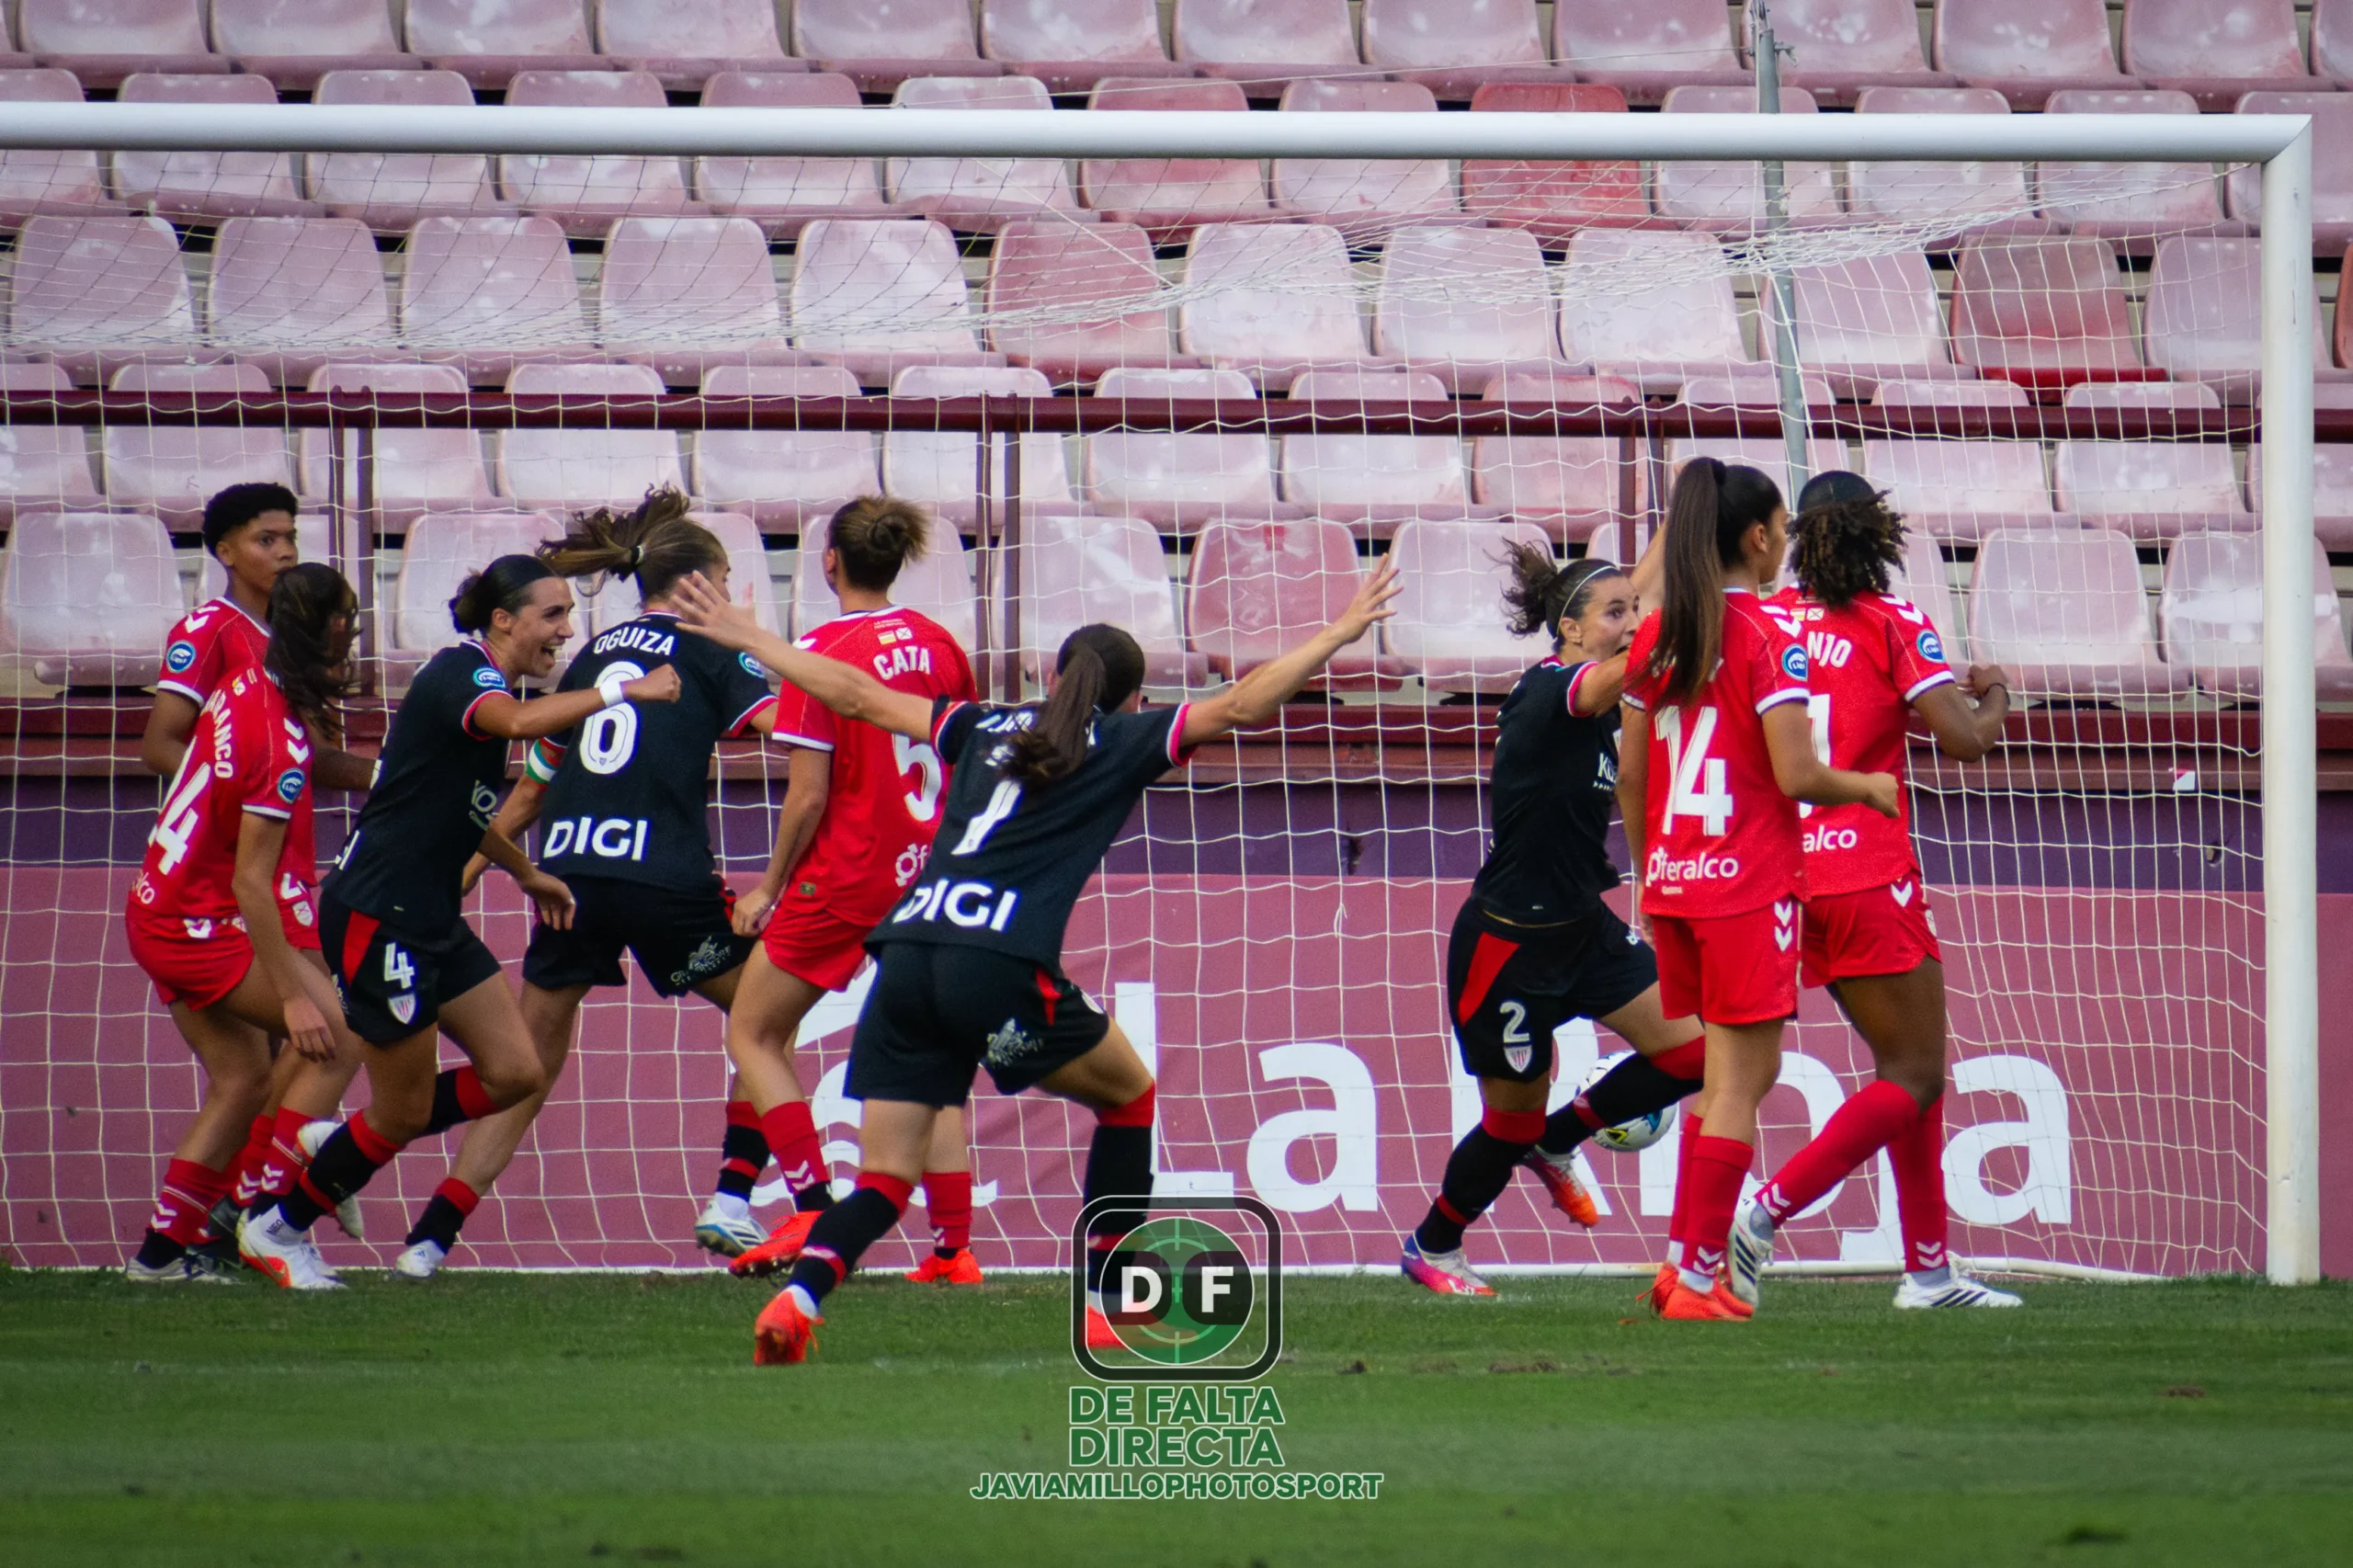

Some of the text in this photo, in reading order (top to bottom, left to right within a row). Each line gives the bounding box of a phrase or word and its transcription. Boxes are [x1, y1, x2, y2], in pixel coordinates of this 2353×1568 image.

[593, 626, 676, 656] OGUIZA
[872, 645, 931, 681] CATA
[1807, 631, 1853, 668] NJO
[891, 733, 943, 822] 5
[1654, 704, 1733, 836] 14
[542, 815, 648, 861] DIGI
[1802, 824, 1858, 854] alco
[892, 877, 1017, 932] DIGI
[383, 941, 415, 991] 4
[1498, 1000, 1530, 1044] 2
